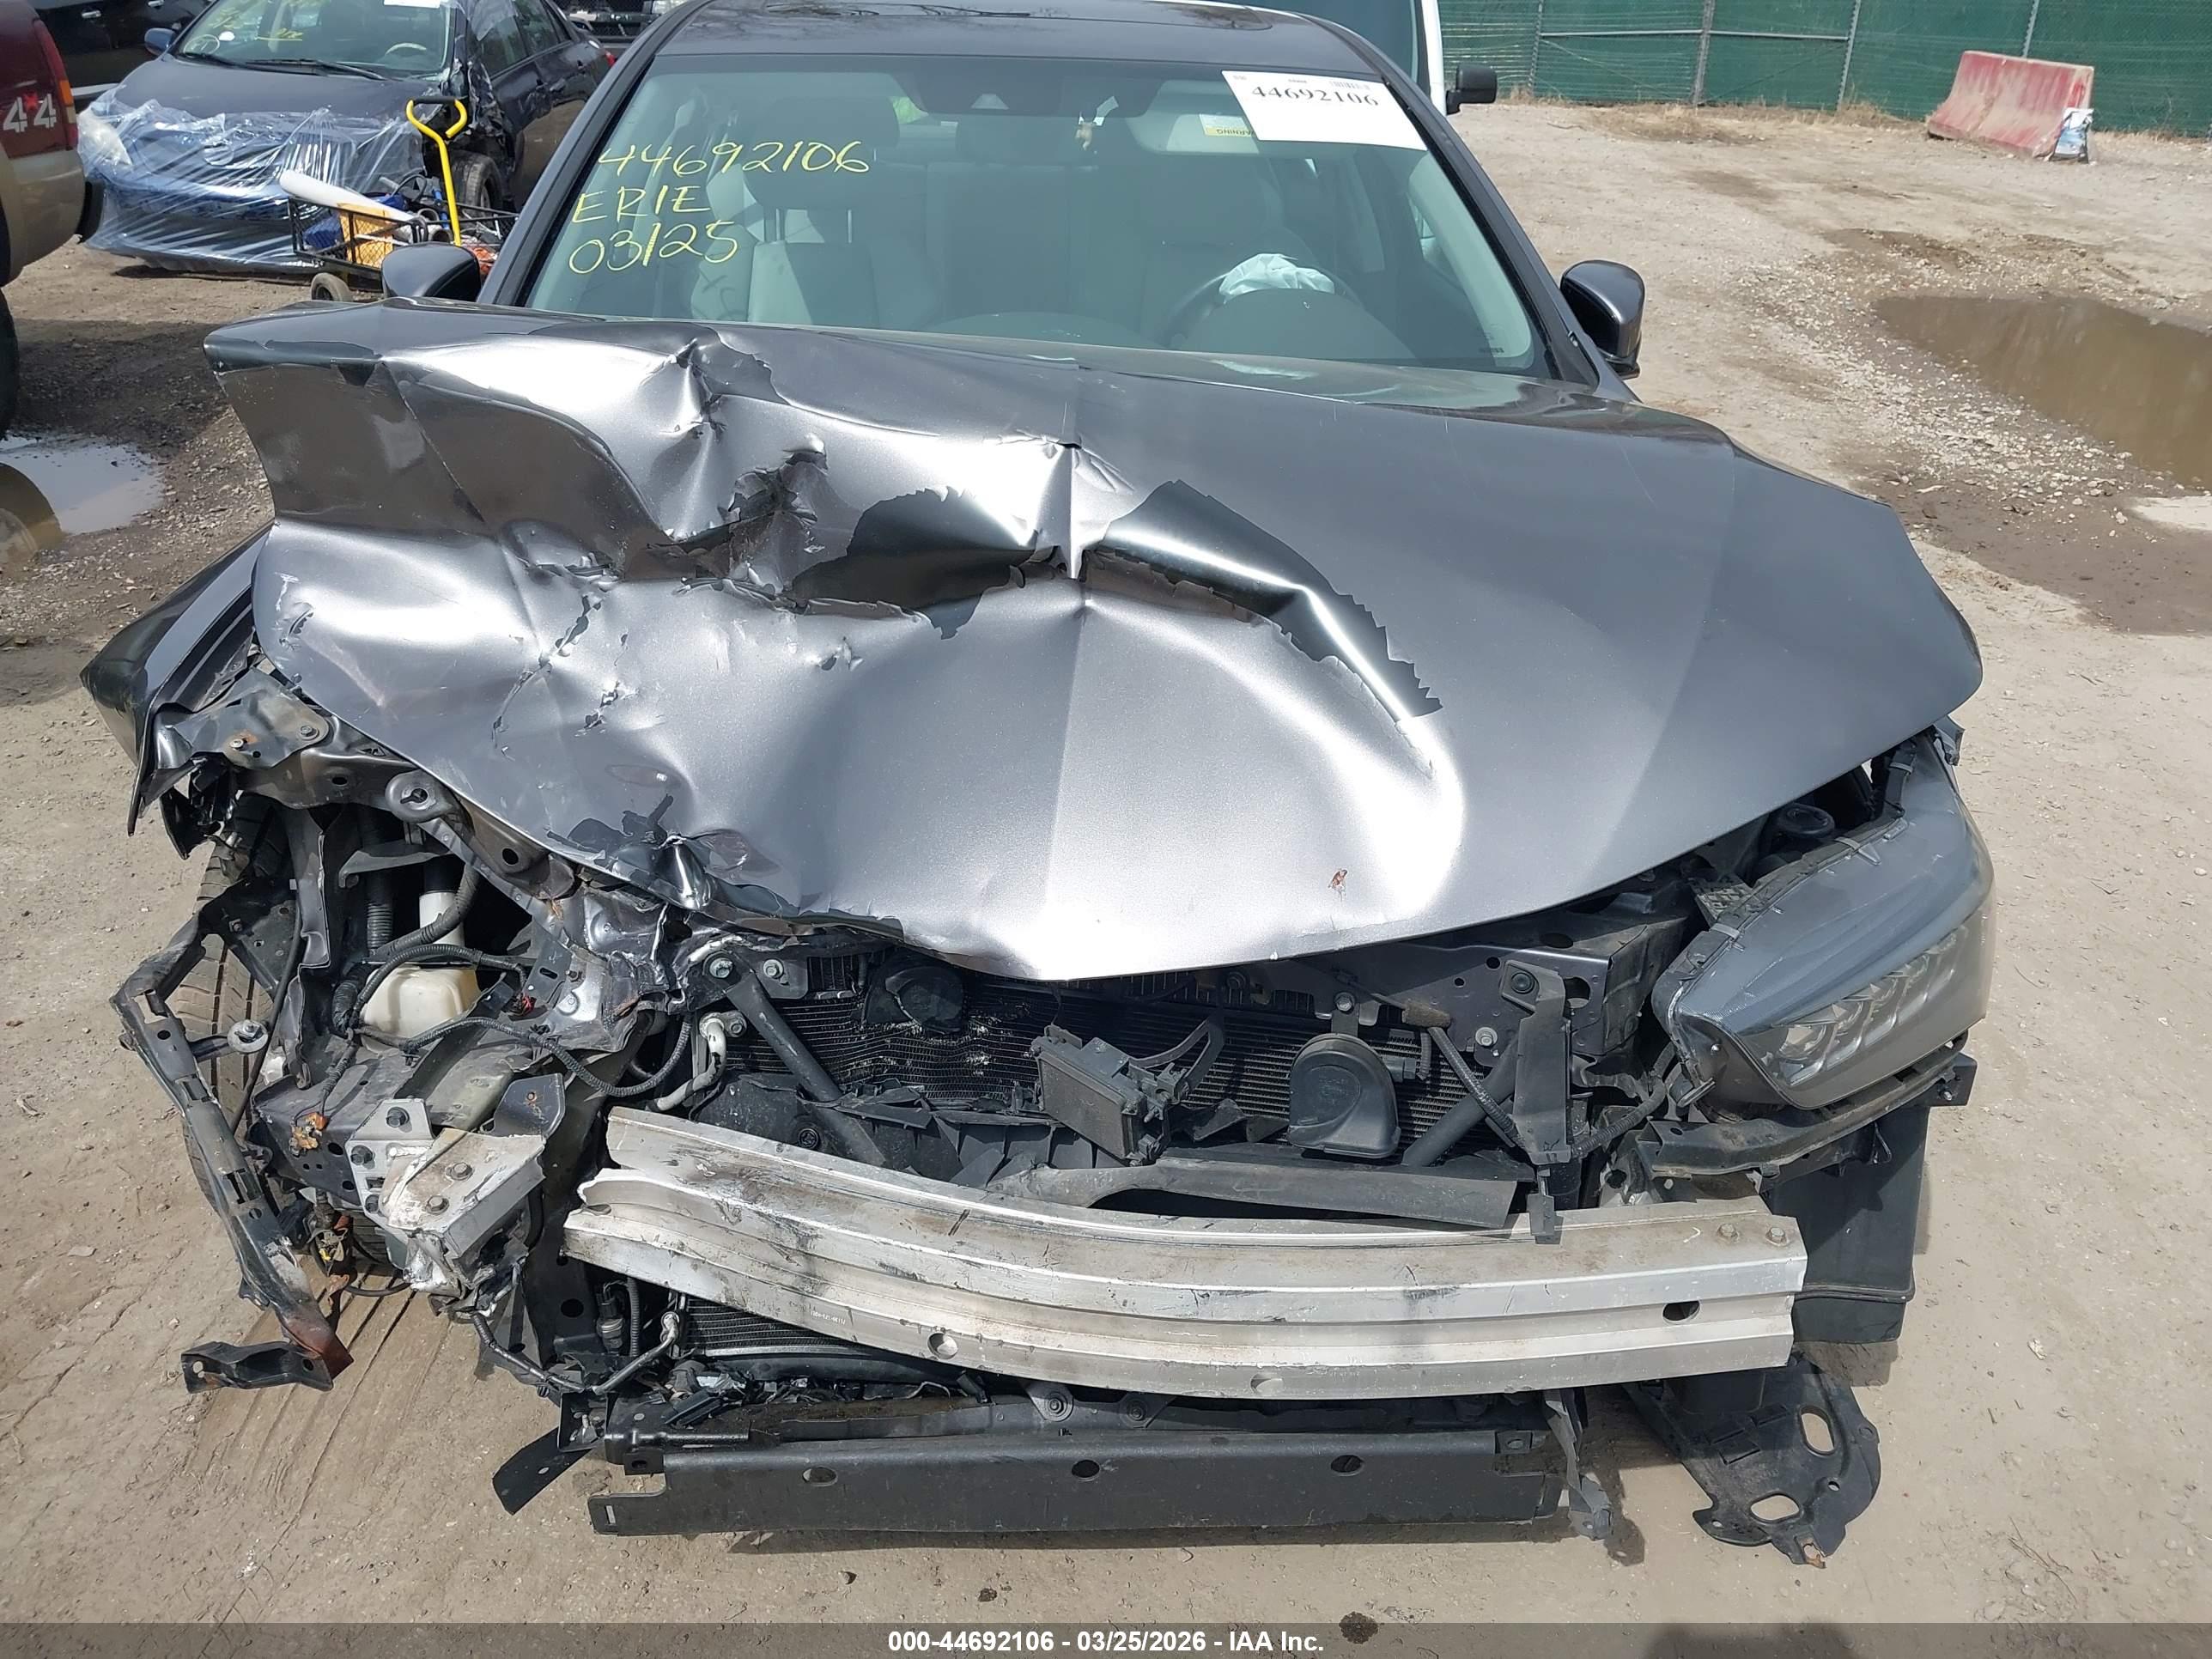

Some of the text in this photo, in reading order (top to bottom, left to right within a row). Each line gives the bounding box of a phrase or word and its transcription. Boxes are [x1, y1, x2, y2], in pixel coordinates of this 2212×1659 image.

[1251, 86, 1379, 106] 44692106
[598, 140, 870, 178] 44692106
[571, 184, 711, 224] ERIE
[568, 219, 738, 275] 03/25
